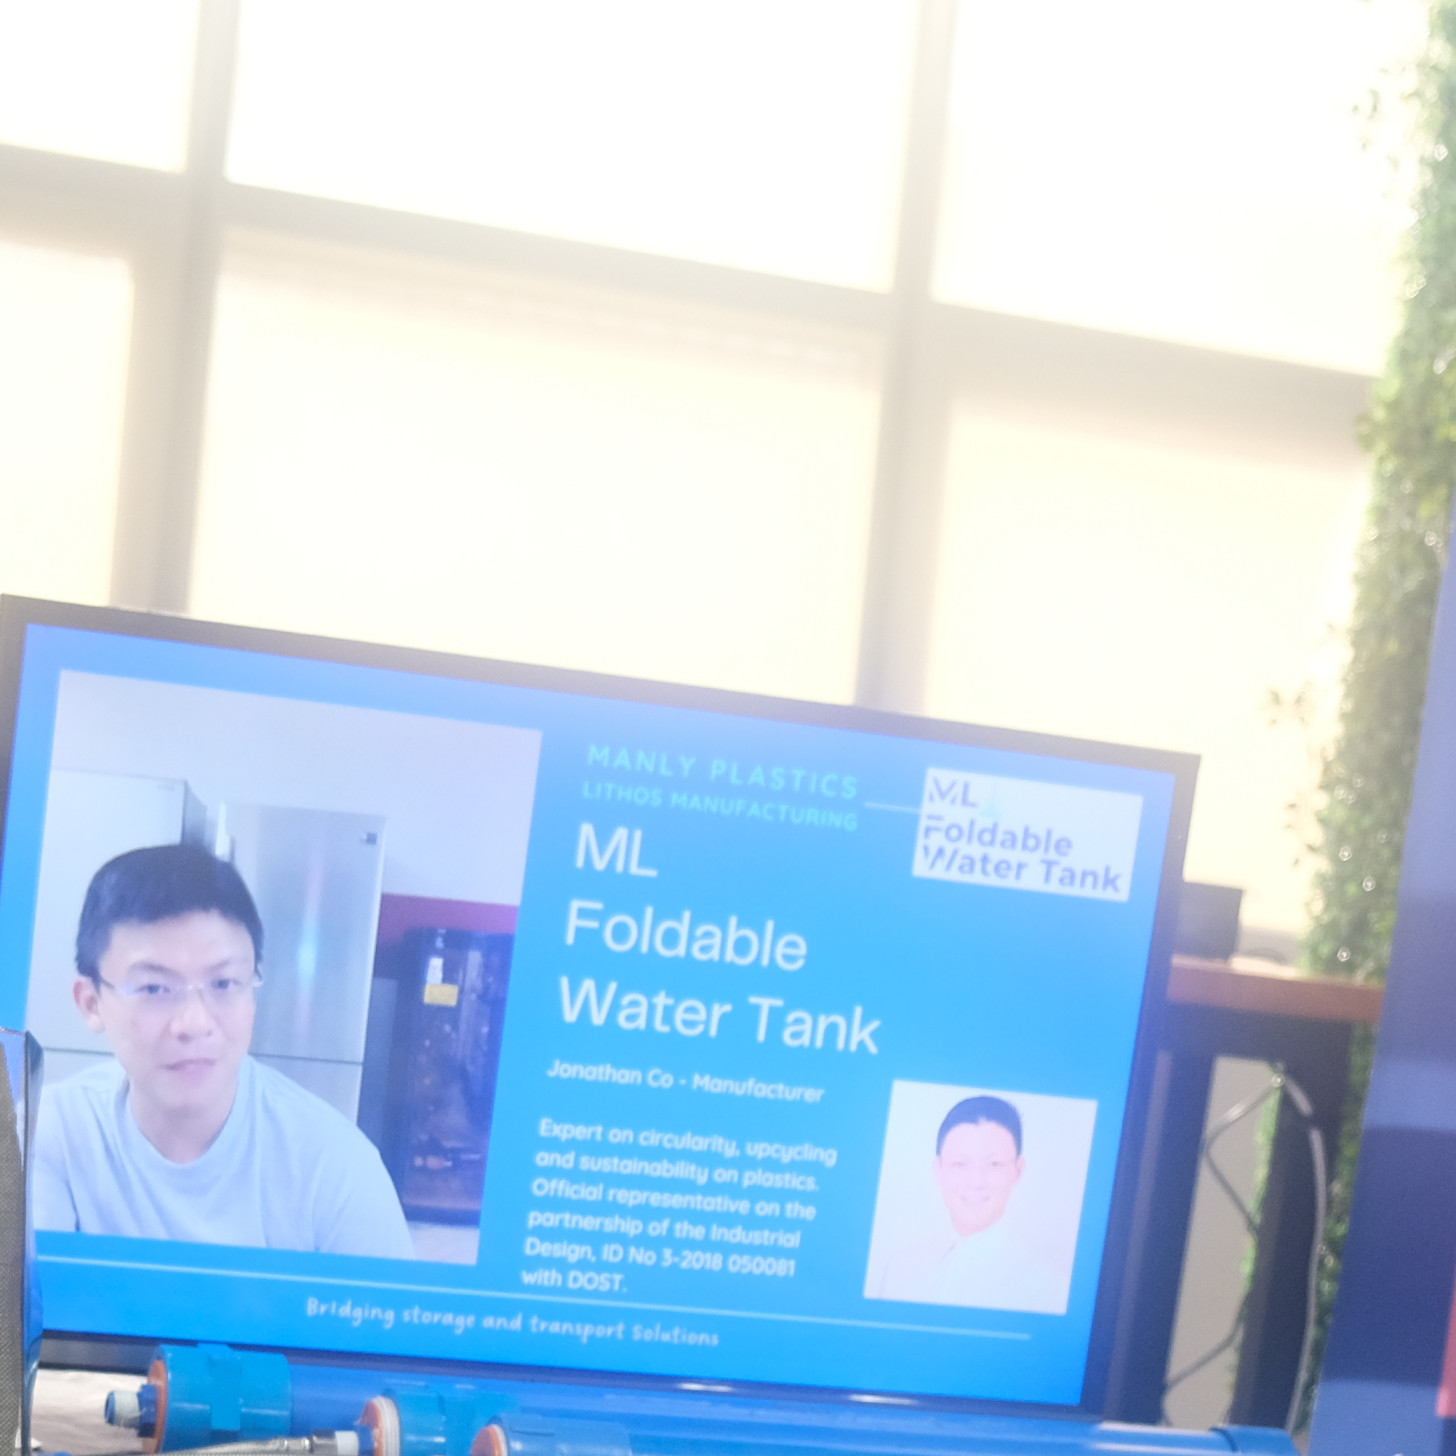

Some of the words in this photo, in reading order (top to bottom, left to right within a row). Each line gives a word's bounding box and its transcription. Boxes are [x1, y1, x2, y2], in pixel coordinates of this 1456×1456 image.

[587, 745, 696, 778] MANLY
[710, 758, 858, 799] PLASTICS
[928, 776, 979, 809] ML
[582, 781, 662, 806] LITHOS
[670, 791, 858, 831] MANUFACTURING
[575, 821, 658, 878] ML
[924, 814, 1073, 858] Foldable
[922, 844, 1029, 881] Water
[1040, 859, 1122, 894] Tank
[565, 899, 808, 972] Foldable
[559, 975, 732, 1038] Water
[748, 996, 882, 1055] Tank
[547, 1059, 641, 1084] Jonathan
[647, 1068, 674, 1088] Co
[692, 1074, 824, 1103] Manufacturer
[538, 1117, 602, 1142] Expert
[608, 1128, 634, 1144] on
[639, 1129, 741, 1158] circularity,
[746, 1141, 838, 1168] upcycling
[535, 1150, 575, 1169] and
[579, 1153, 709, 1185] sustainability
[713, 1167, 738, 1183] on
[742, 1169, 820, 1192] plastics.
[531, 1177, 603, 1200] Official
[608, 1186, 751, 1215] representative
[754, 1200, 780, 1216] on
[785, 1201, 816, 1221] the
[528, 1210, 643, 1237] partnership
[648, 1218, 671, 1236] of
[674, 1221, 706, 1241] the
[710, 1224, 801, 1248] Industrial
[524, 1237, 596, 1262] Design,
[602, 1244, 624, 1263] ID
[629, 1247, 657, 1265] No
[661, 1249, 723, 1271] 3-2018
[521, 1269, 562, 1286] with
[567, 1270, 628, 1292] DOST.
[305, 1296, 395, 1328] Bridging
[403, 1308, 475, 1335] storage
[483, 1311, 523, 1332] and
[530, 1314, 625, 1345] transport
[633, 1324, 720, 1348] Solutions
